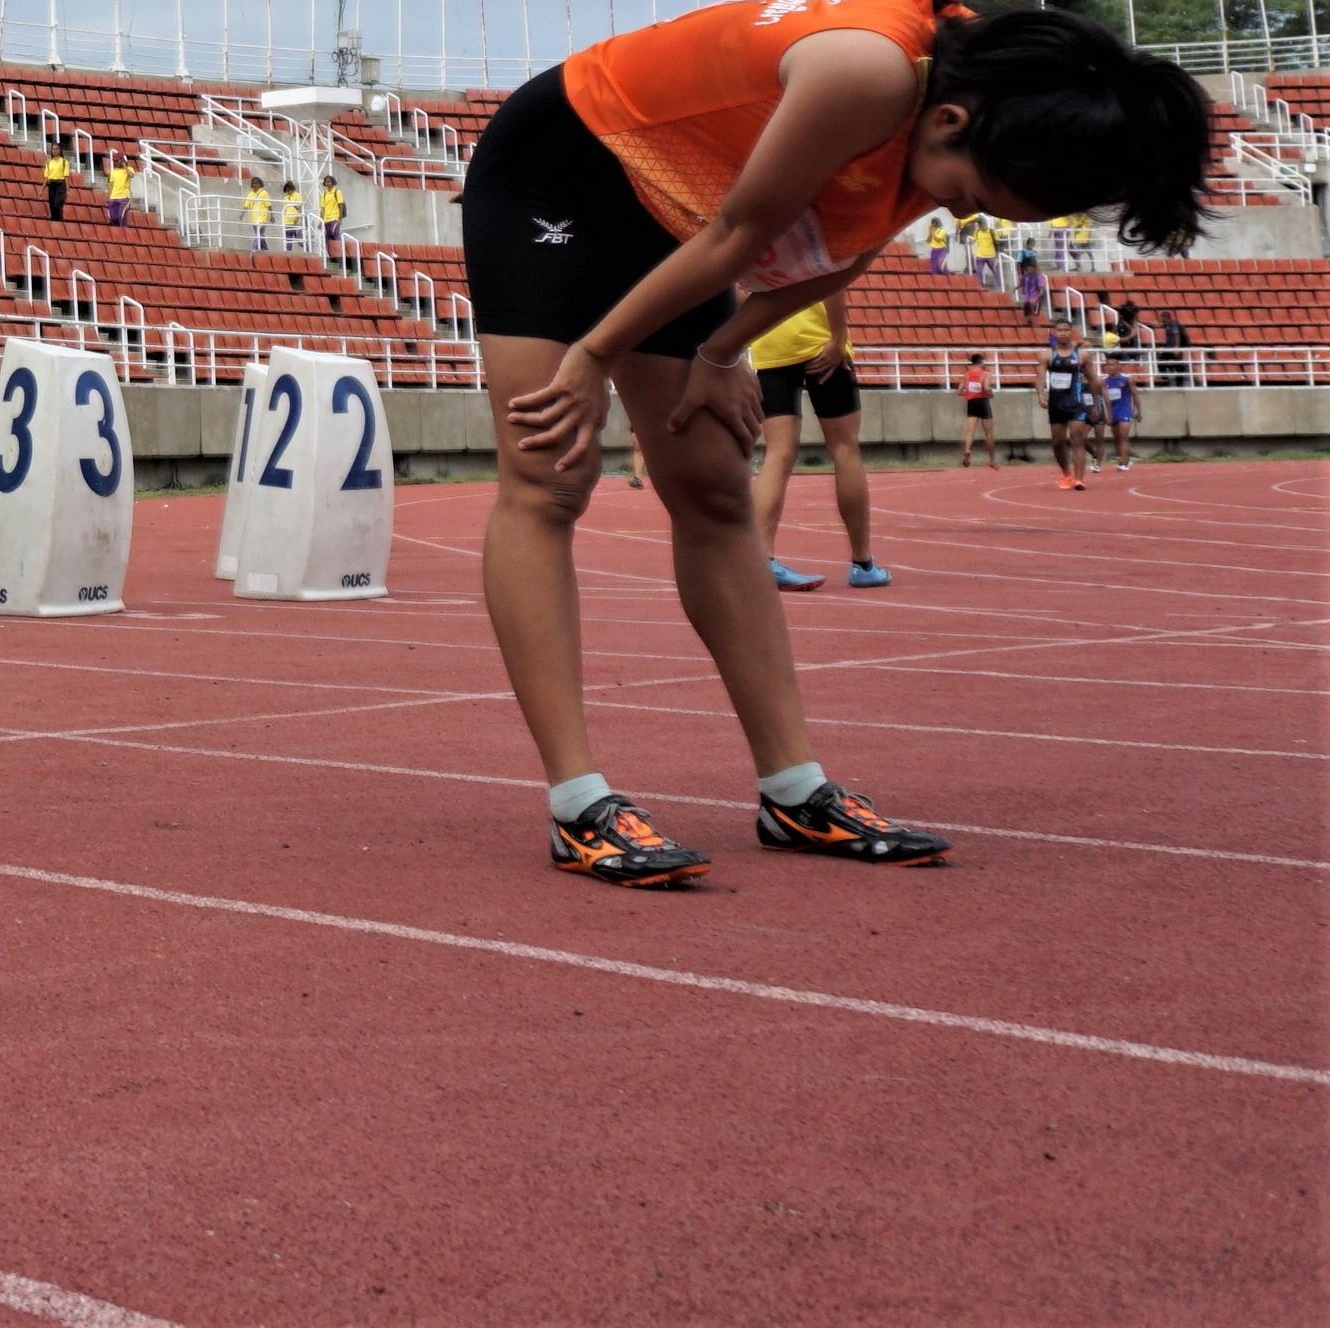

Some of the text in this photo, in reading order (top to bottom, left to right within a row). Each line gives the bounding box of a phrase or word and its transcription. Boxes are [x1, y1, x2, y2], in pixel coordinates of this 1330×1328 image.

[534, 232, 574, 245] FBT
[74, 370, 123, 498] 3
[237, 388, 256, 482] 1
[259, 374, 303, 489] 2
[332, 375, 383, 491] 2
[88, 584, 109, 601] UCS
[351, 572, 371, 588] UCS
